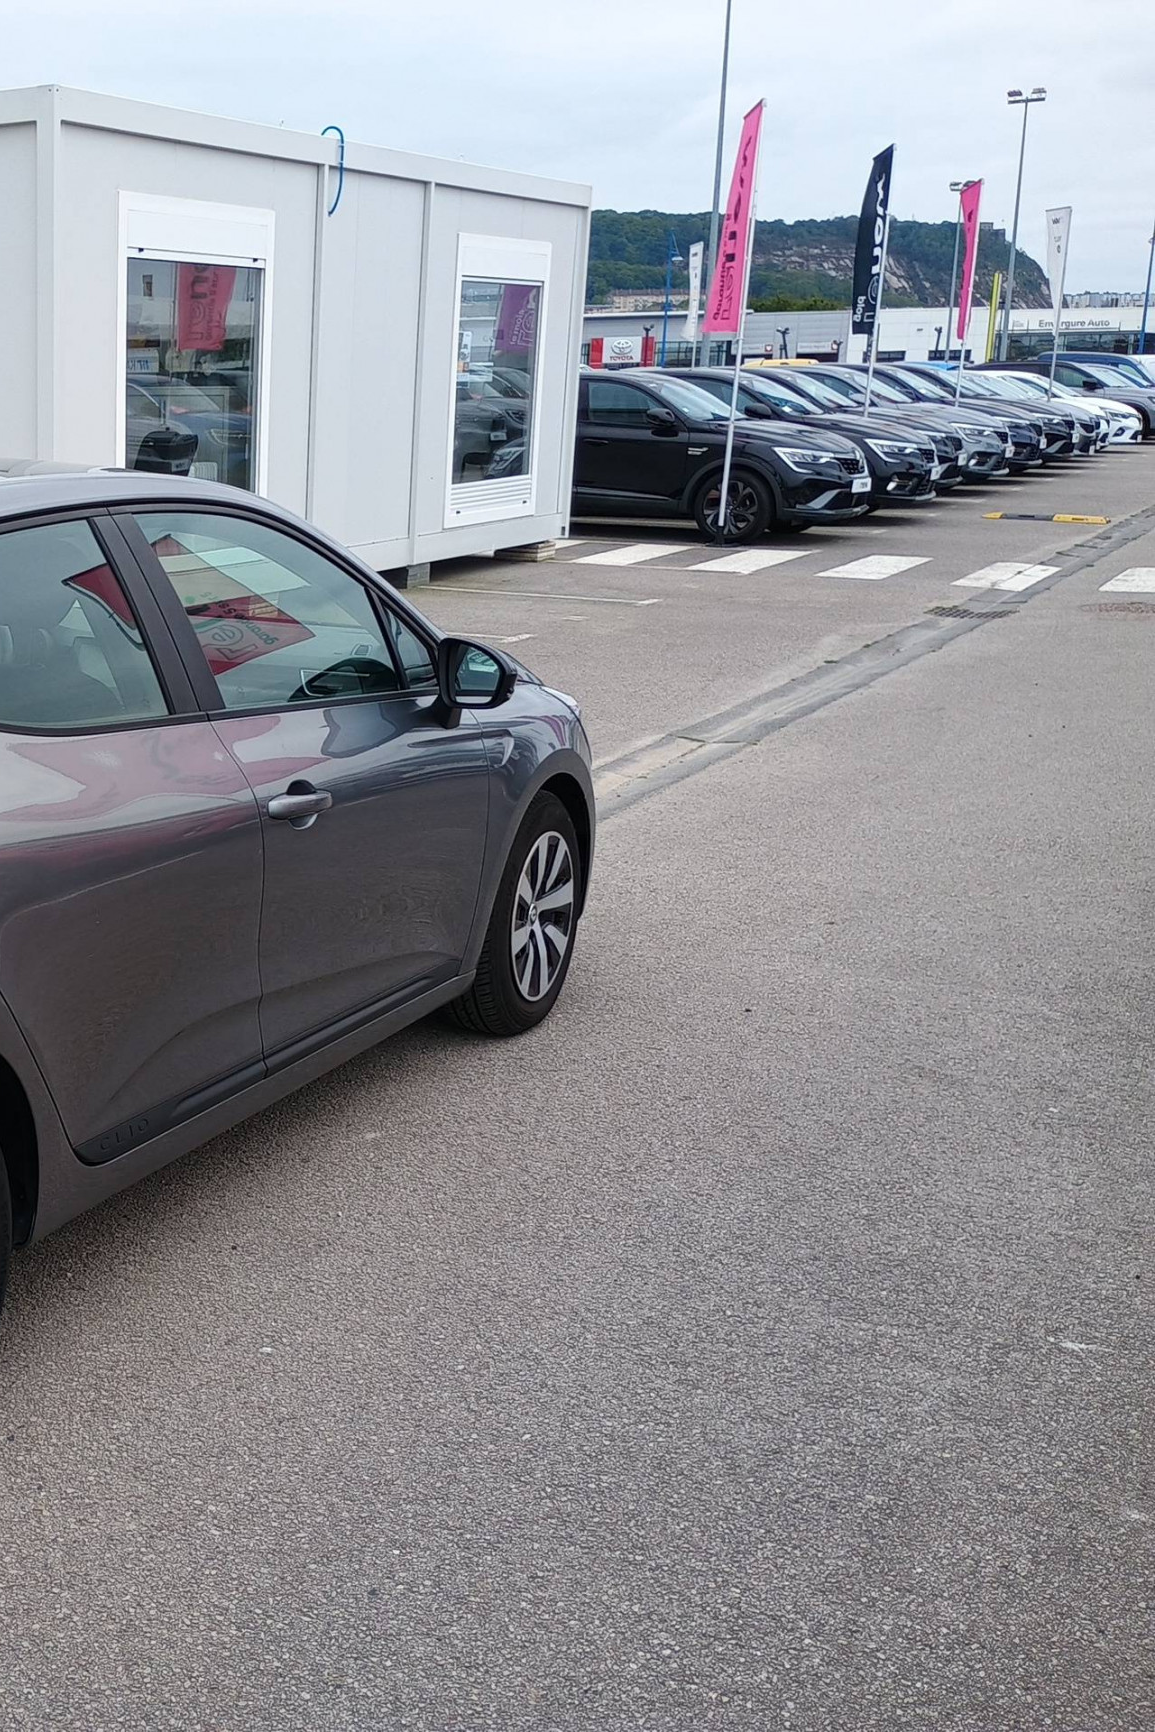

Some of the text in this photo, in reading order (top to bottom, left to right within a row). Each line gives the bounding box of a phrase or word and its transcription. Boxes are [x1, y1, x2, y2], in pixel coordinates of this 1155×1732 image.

[1038, 319, 1110, 329] Envrgure Auto
[100, 1118, 149, 1151] CLIO
